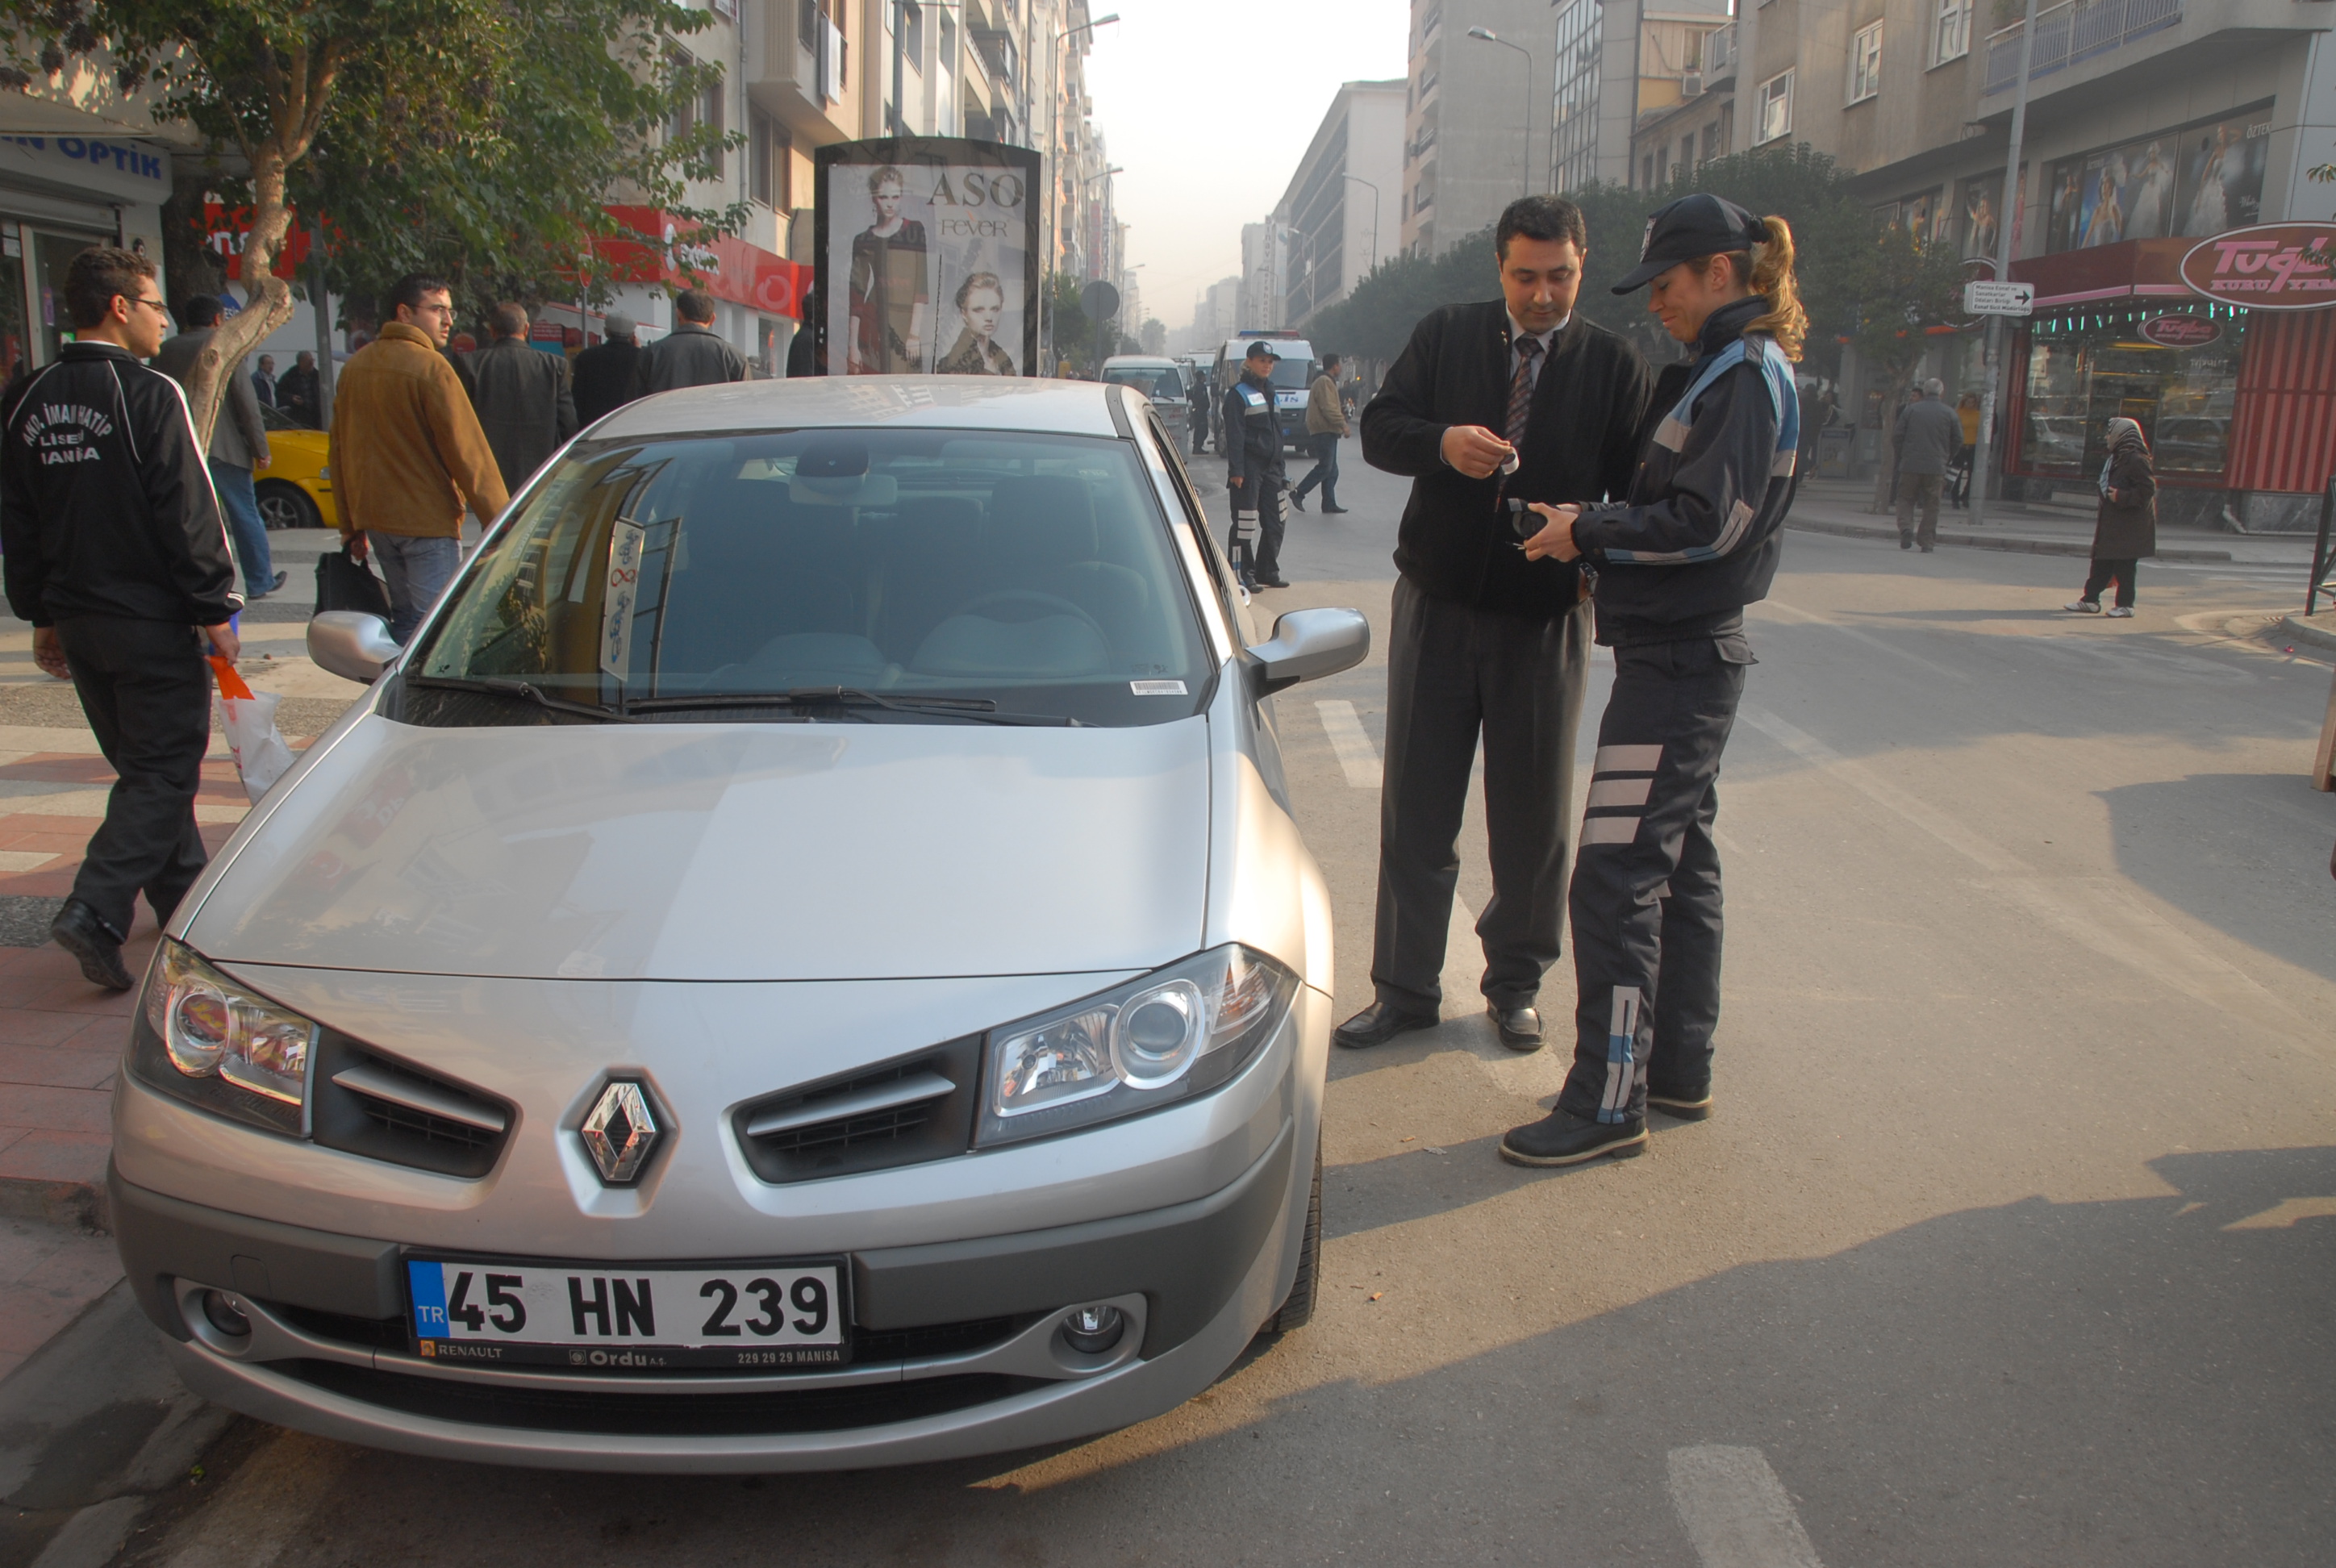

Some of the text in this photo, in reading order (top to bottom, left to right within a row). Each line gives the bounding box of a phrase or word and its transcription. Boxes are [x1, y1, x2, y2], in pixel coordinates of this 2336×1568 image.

[926, 172, 1024, 208] ASO
[418, 1271, 828, 1337] TR 45 HN 239
[438, 1345, 503, 1358] RENAULT
[590, 1350, 647, 1366] Ordu
[738, 1353, 758, 1364] 229
[762, 1353, 776, 1363] 29
[779, 1352, 793, 1363] 29
